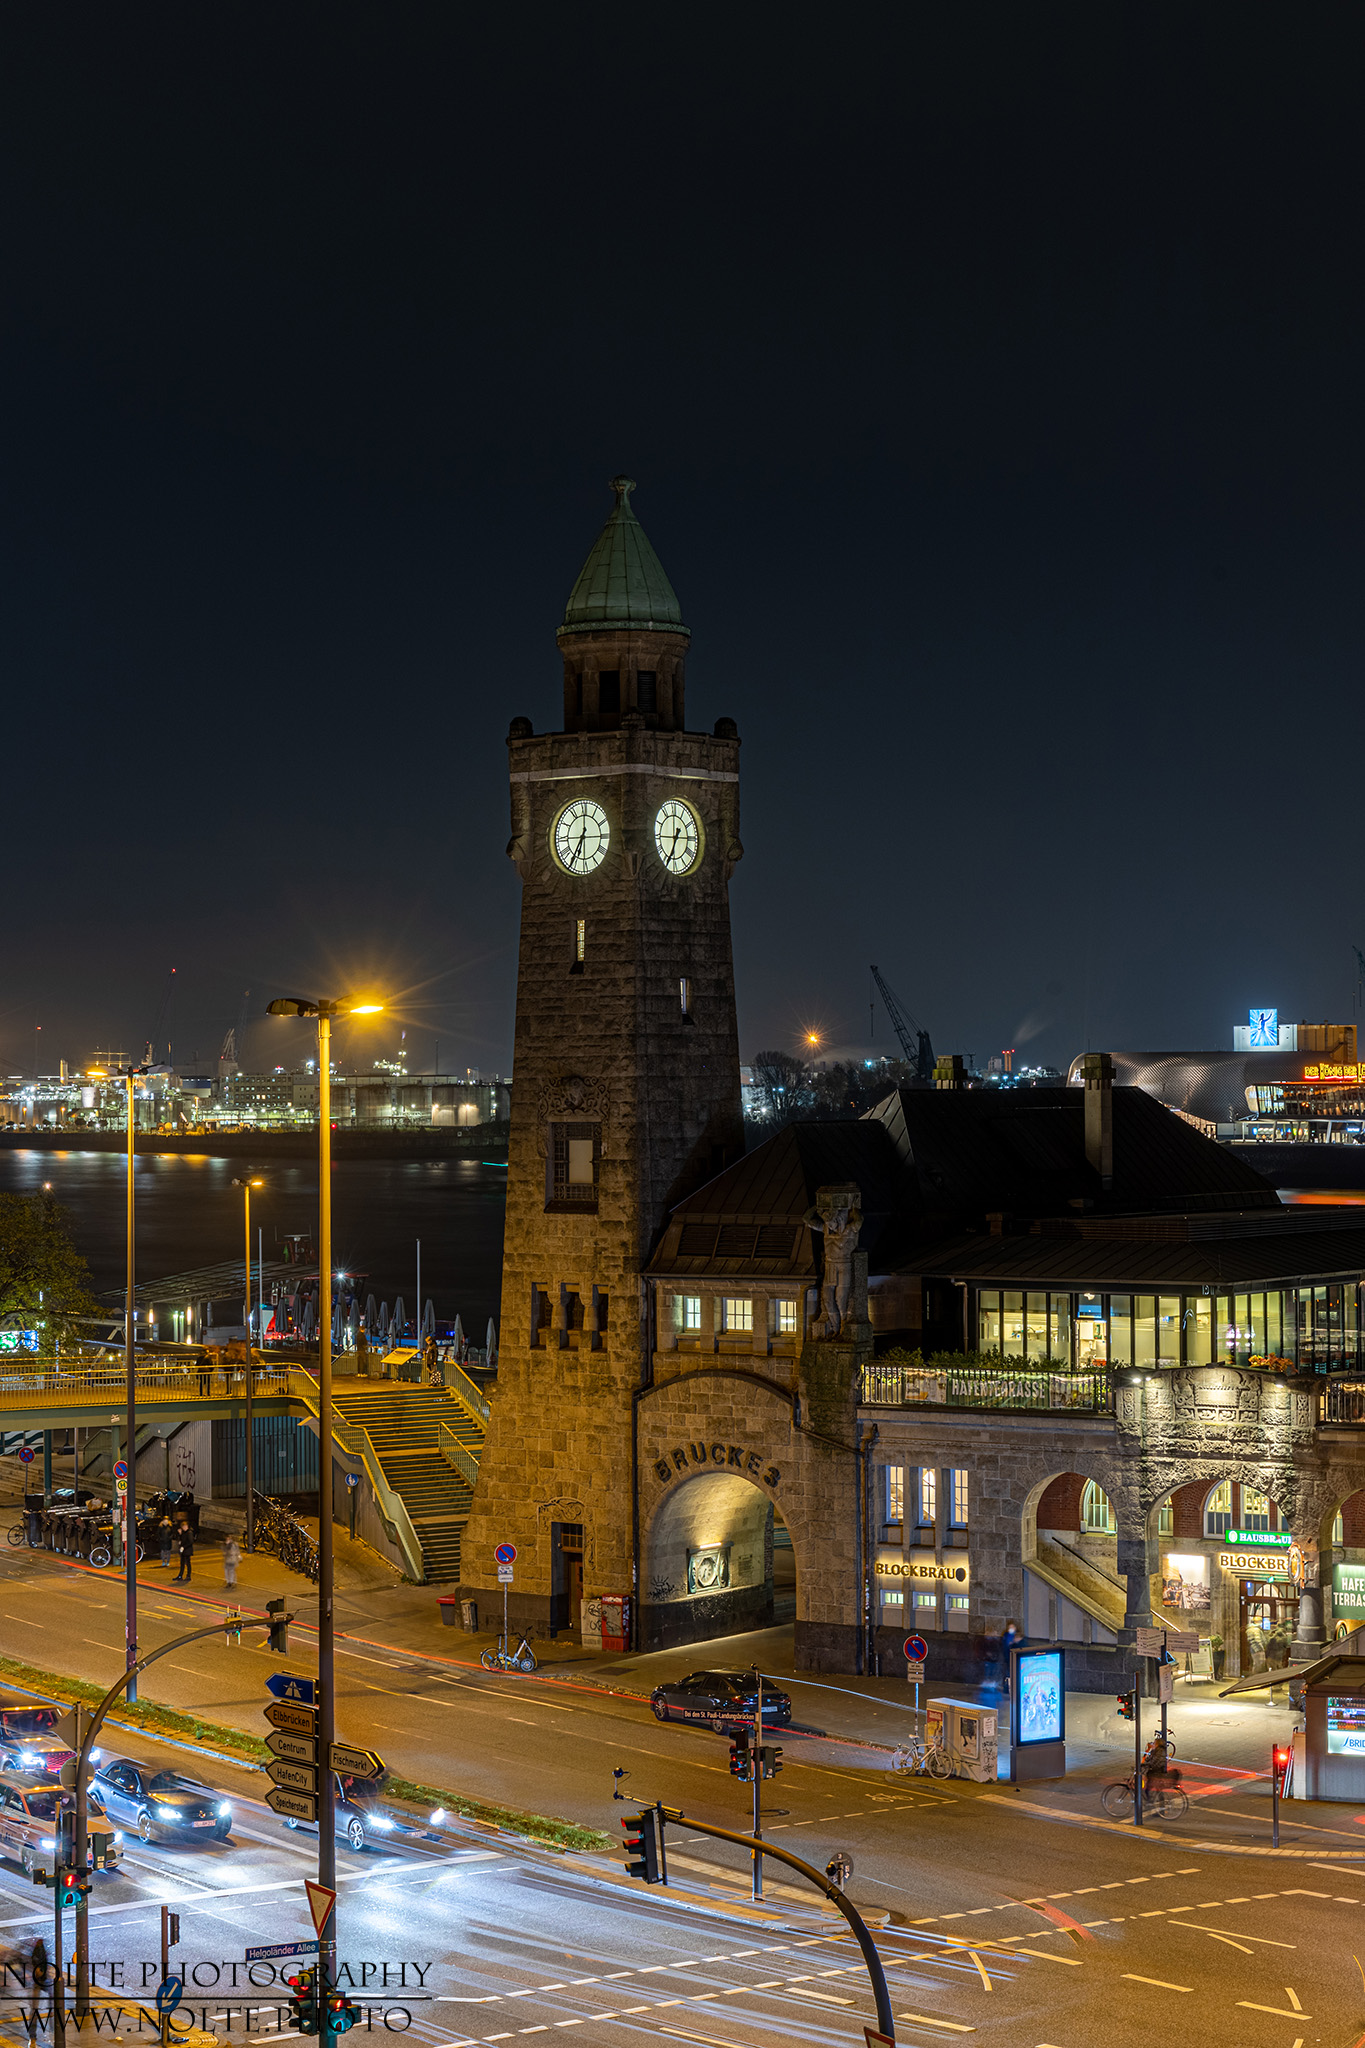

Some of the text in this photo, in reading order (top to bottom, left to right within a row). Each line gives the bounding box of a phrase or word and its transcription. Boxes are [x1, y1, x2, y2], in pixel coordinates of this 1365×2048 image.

[763, 1466, 781, 1488] 3
[875, 1563, 955, 1580] BLOCKBRÄU
[1220, 1555, 1288, 1571] BLOCKBR
[273, 1710, 310, 1728] Elbbrücken
[278, 1740, 307, 1755] Centrum
[333, 1753, 367, 1771] Fischmarkt
[277, 1768, 307, 1786] HafenCity
[275, 1795, 308, 1814] Speicherstadt
[249, 1943, 316, 1959] Helgoländer Allee
